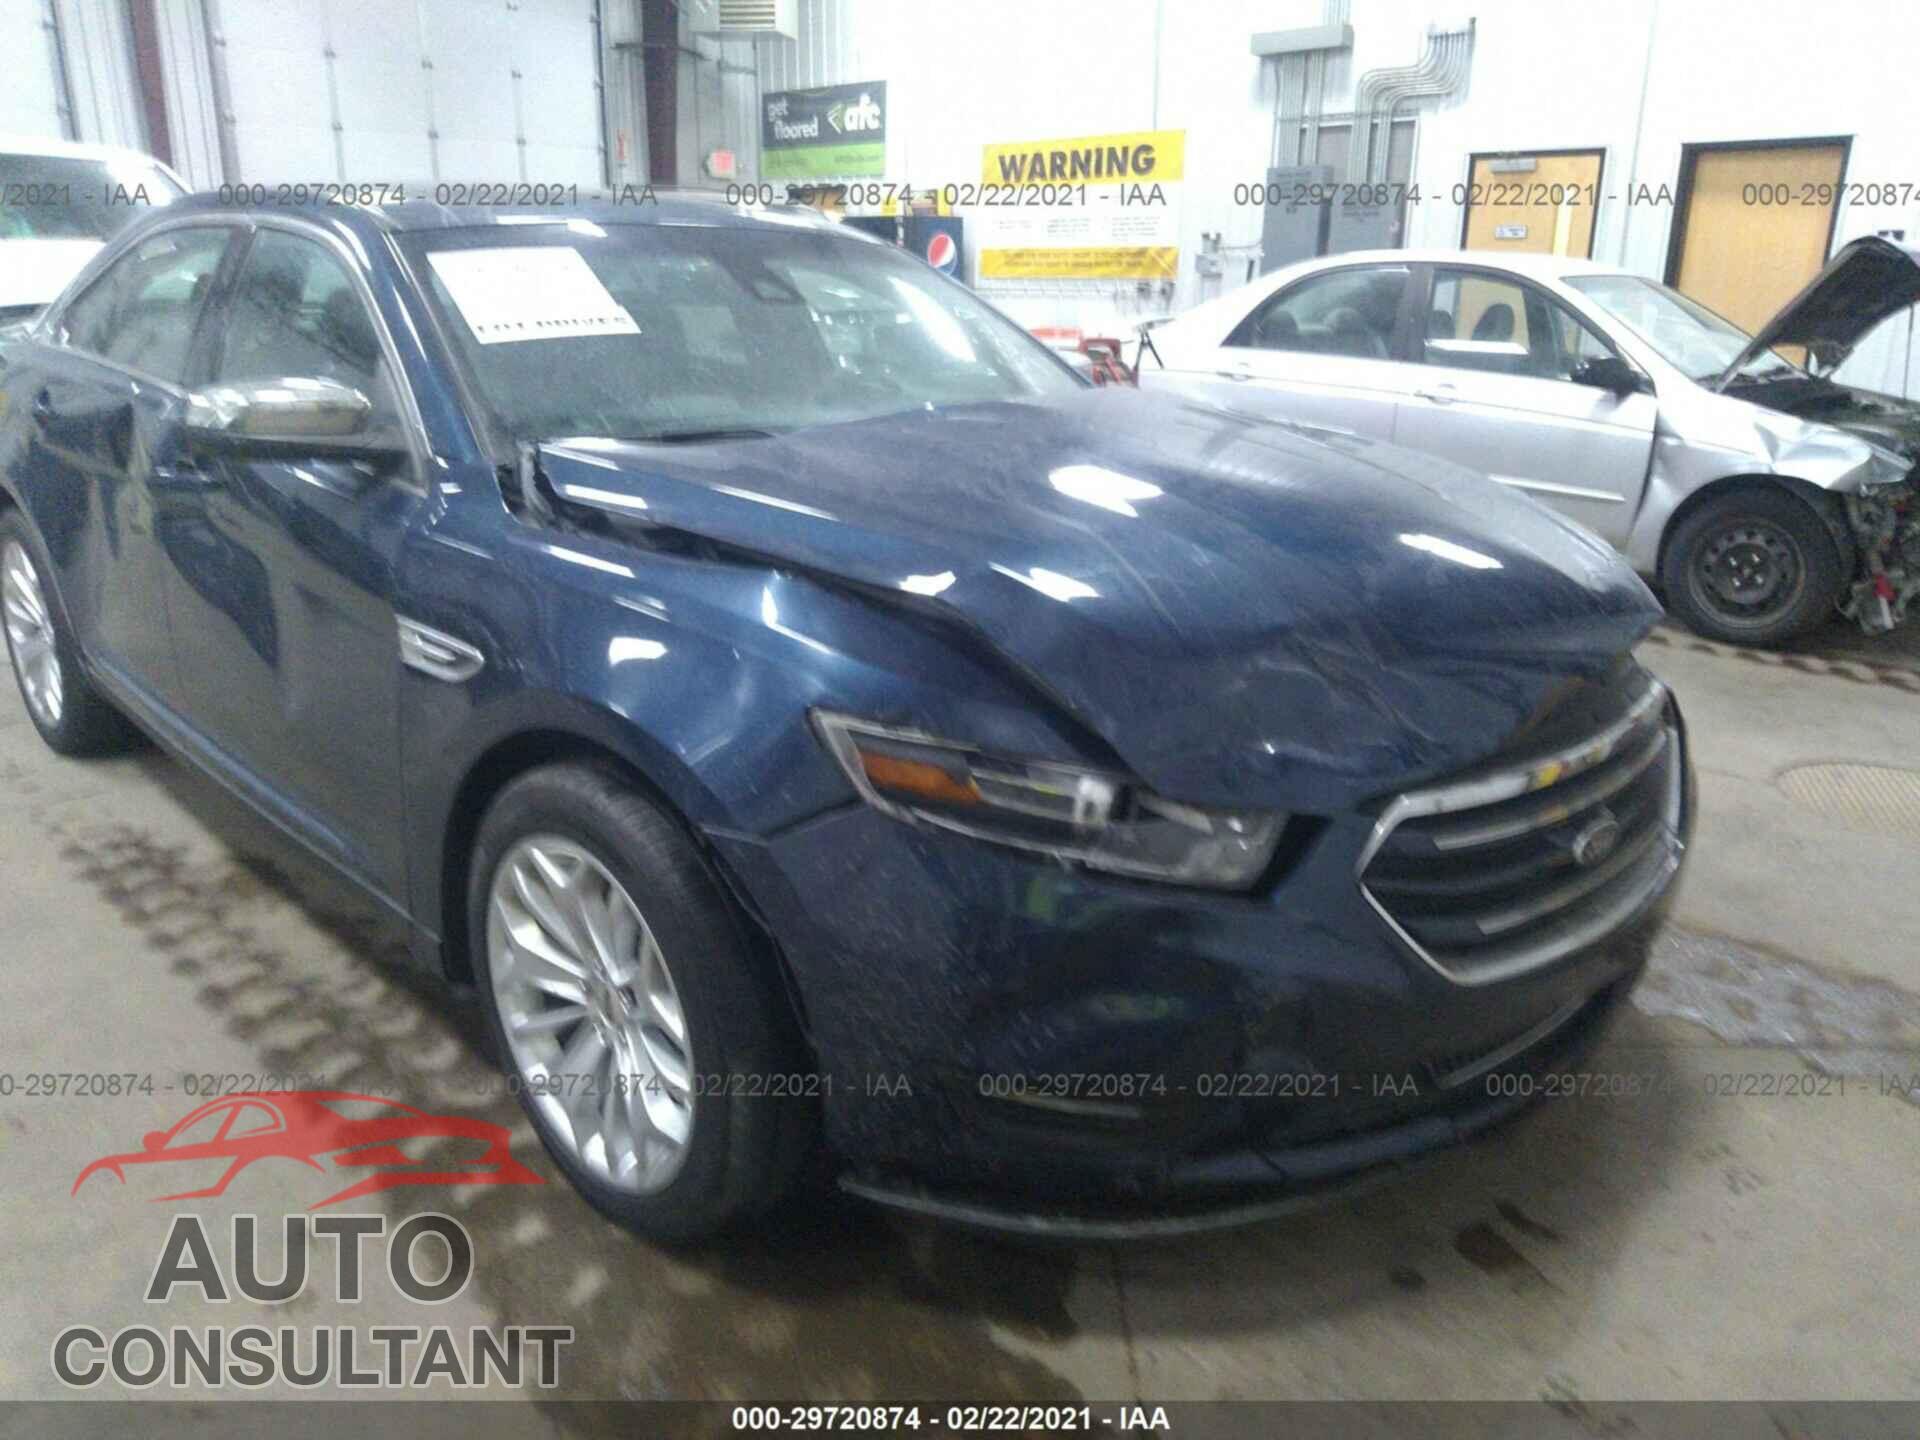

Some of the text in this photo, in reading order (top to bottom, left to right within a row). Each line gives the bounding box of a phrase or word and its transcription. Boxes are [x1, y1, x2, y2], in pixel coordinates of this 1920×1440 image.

[768, 97, 789, 122] get
[844, 93, 881, 131] afc
[775, 117, 819, 140] floored
[999, 143, 1156, 183] WARNING
